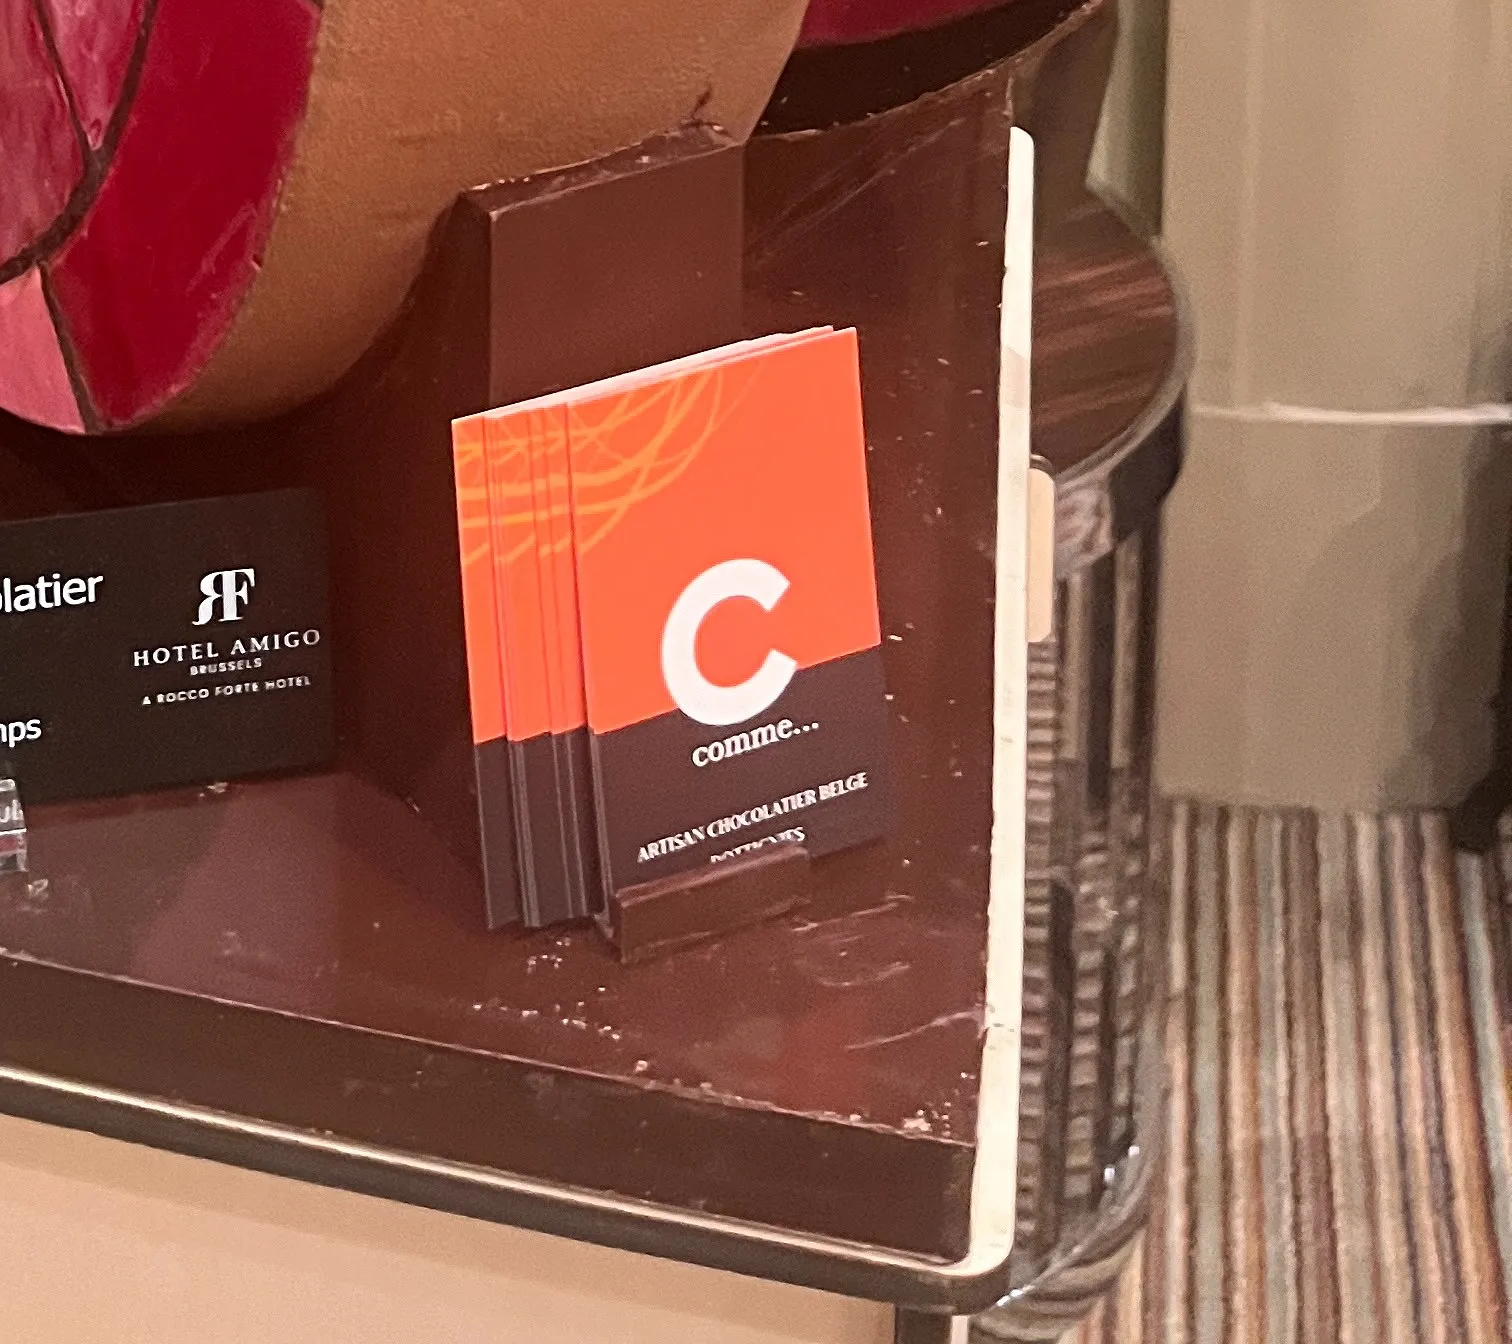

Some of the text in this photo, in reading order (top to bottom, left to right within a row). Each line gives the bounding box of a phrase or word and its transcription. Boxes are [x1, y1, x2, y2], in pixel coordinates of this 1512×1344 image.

[133, 629, 320, 667] HOTEL AMIGO
[661, 558, 798, 727] C
[190, 657, 262, 676] BRUSSELS
[142, 675, 311, 705] A ROCCO FORTE HOTEL
[691, 718, 819, 768] comme...
[637, 825, 706, 863] ARTISAN
[706, 788, 817, 838] CHOCOLATIER
[818, 771, 869, 801] BELGE
